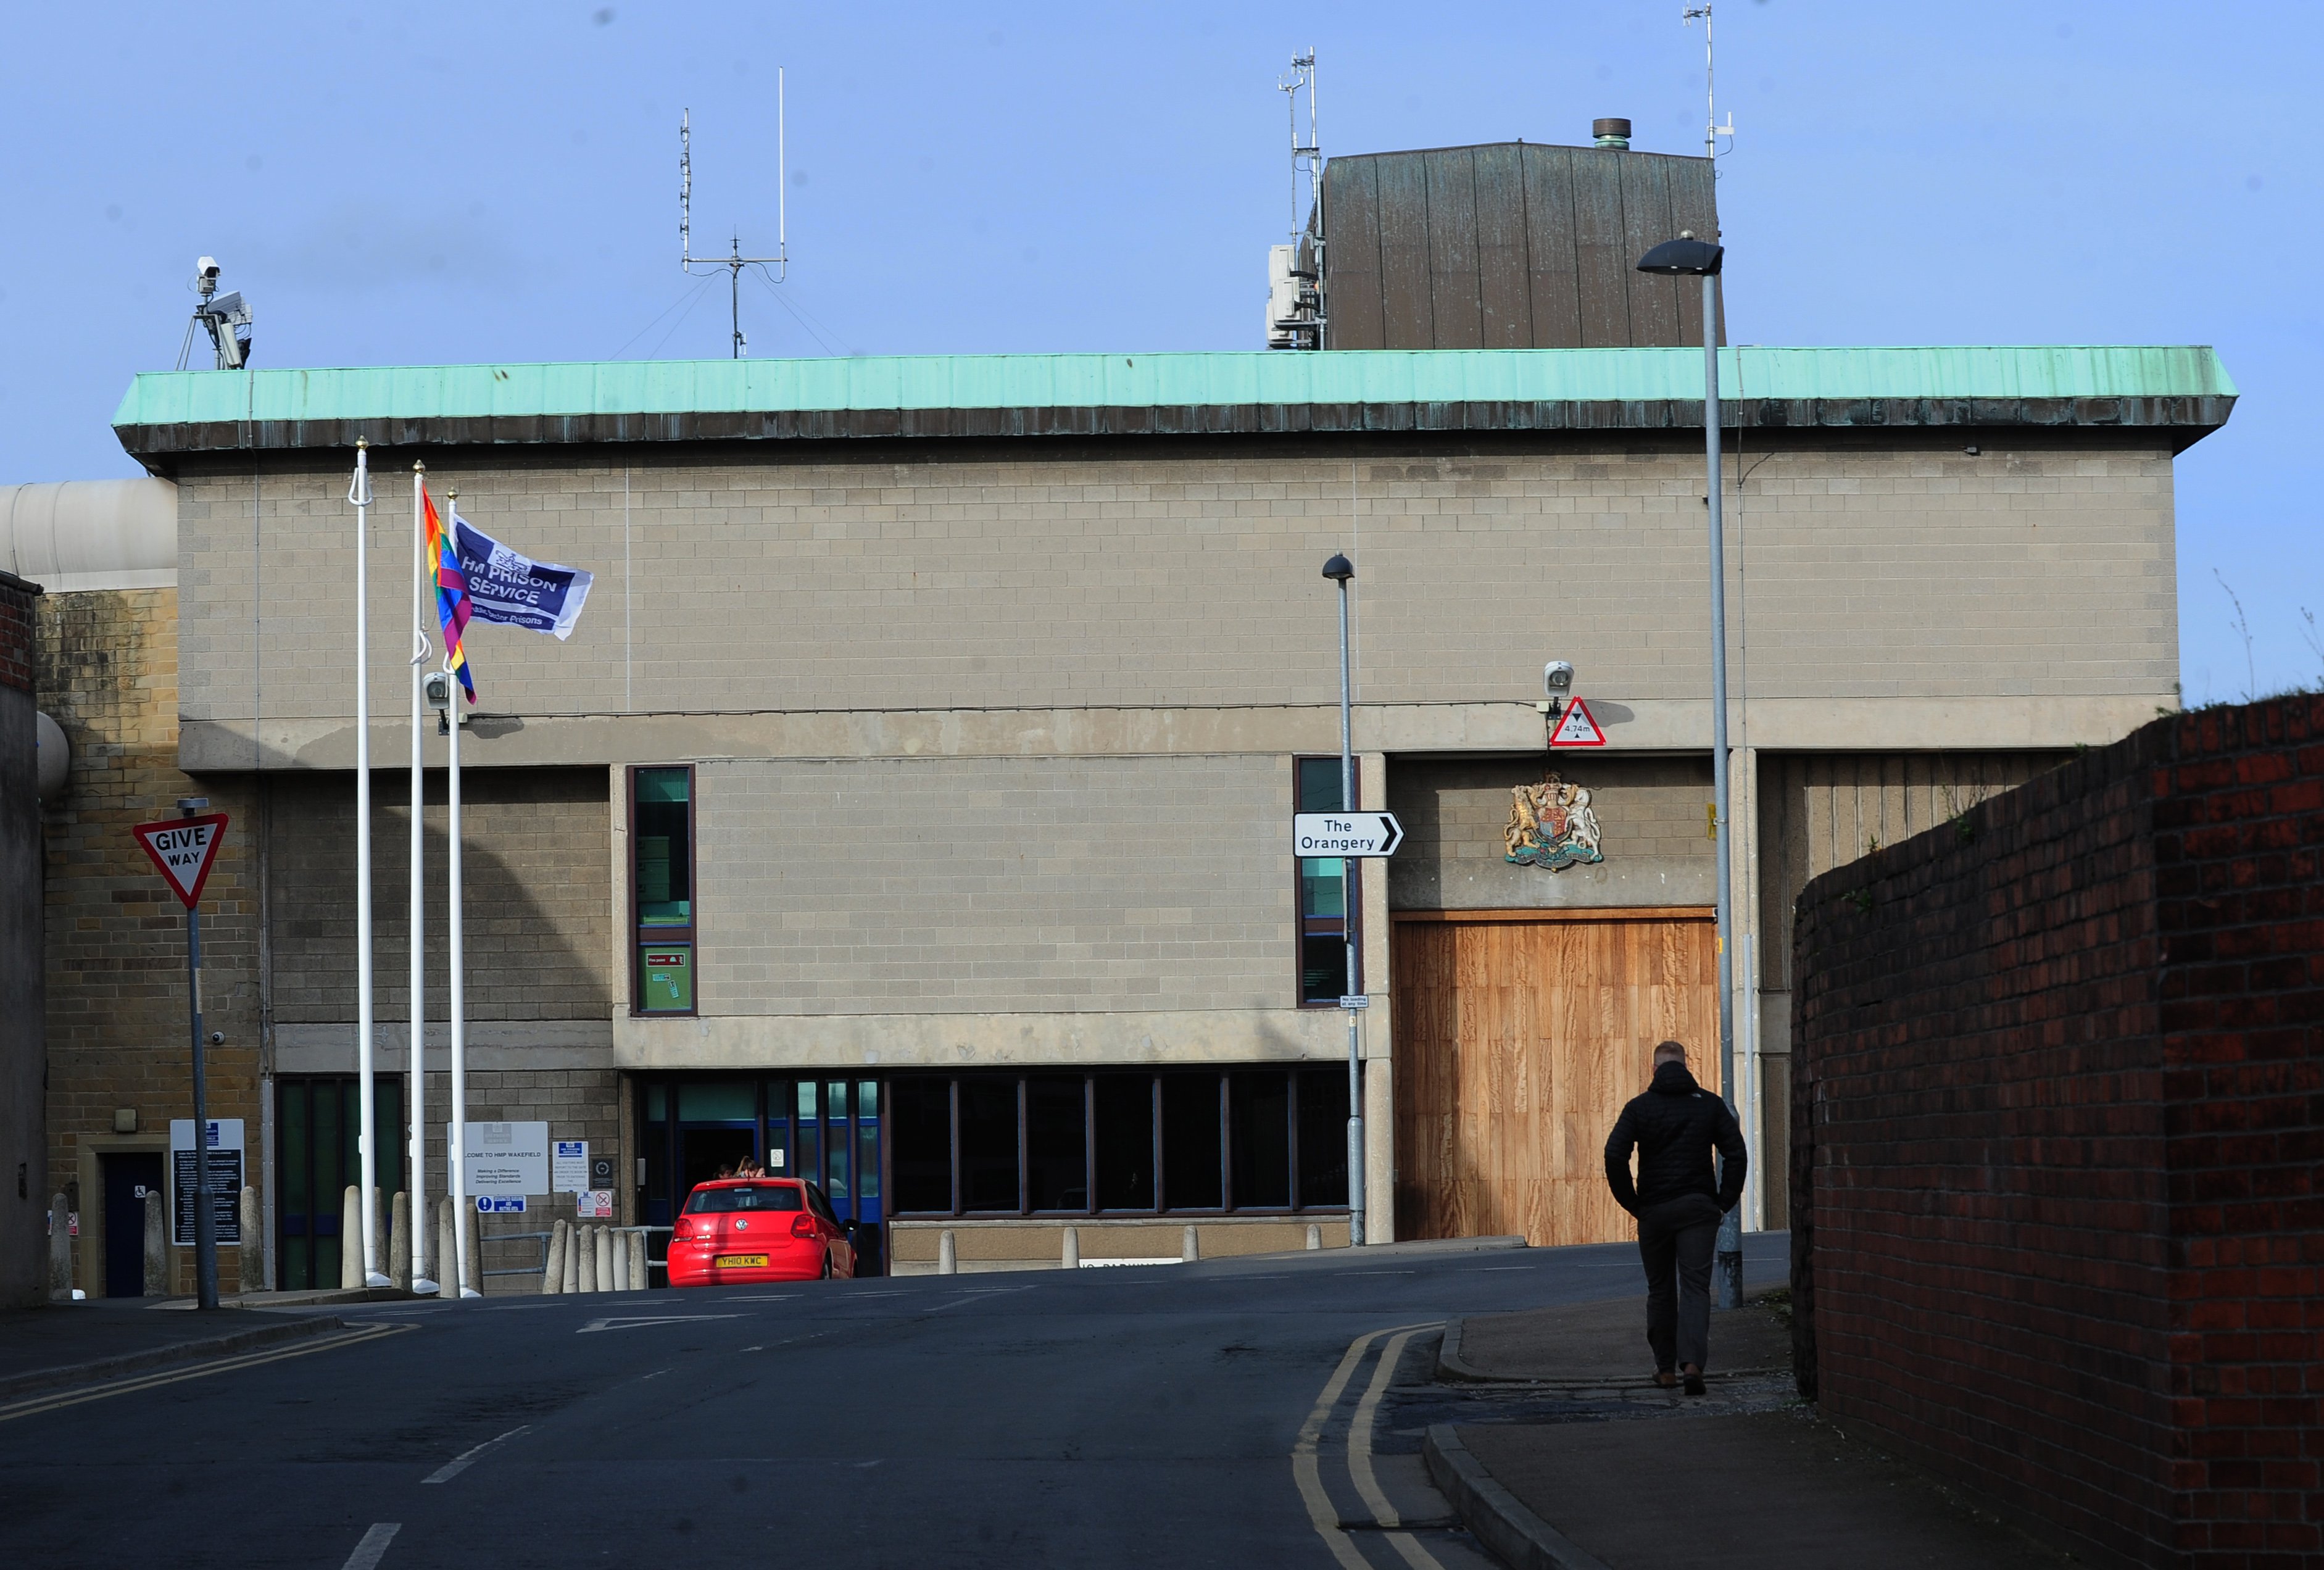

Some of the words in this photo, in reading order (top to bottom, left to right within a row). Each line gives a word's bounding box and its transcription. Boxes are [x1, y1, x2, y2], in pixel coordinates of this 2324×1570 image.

[462, 557, 485, 574] HM
[488, 566, 557, 592] PRISON
[469, 576, 541, 604] SERVICE
[471, 605, 488, 615] ublic
[510, 615, 542, 625] Prisons
[1324, 820, 1352, 832] The
[156, 827, 207, 850] GIVE
[1301, 836, 1374, 851] Orangery
[168, 852, 200, 866] WAY
[722, 1257, 741, 1265] YH10
